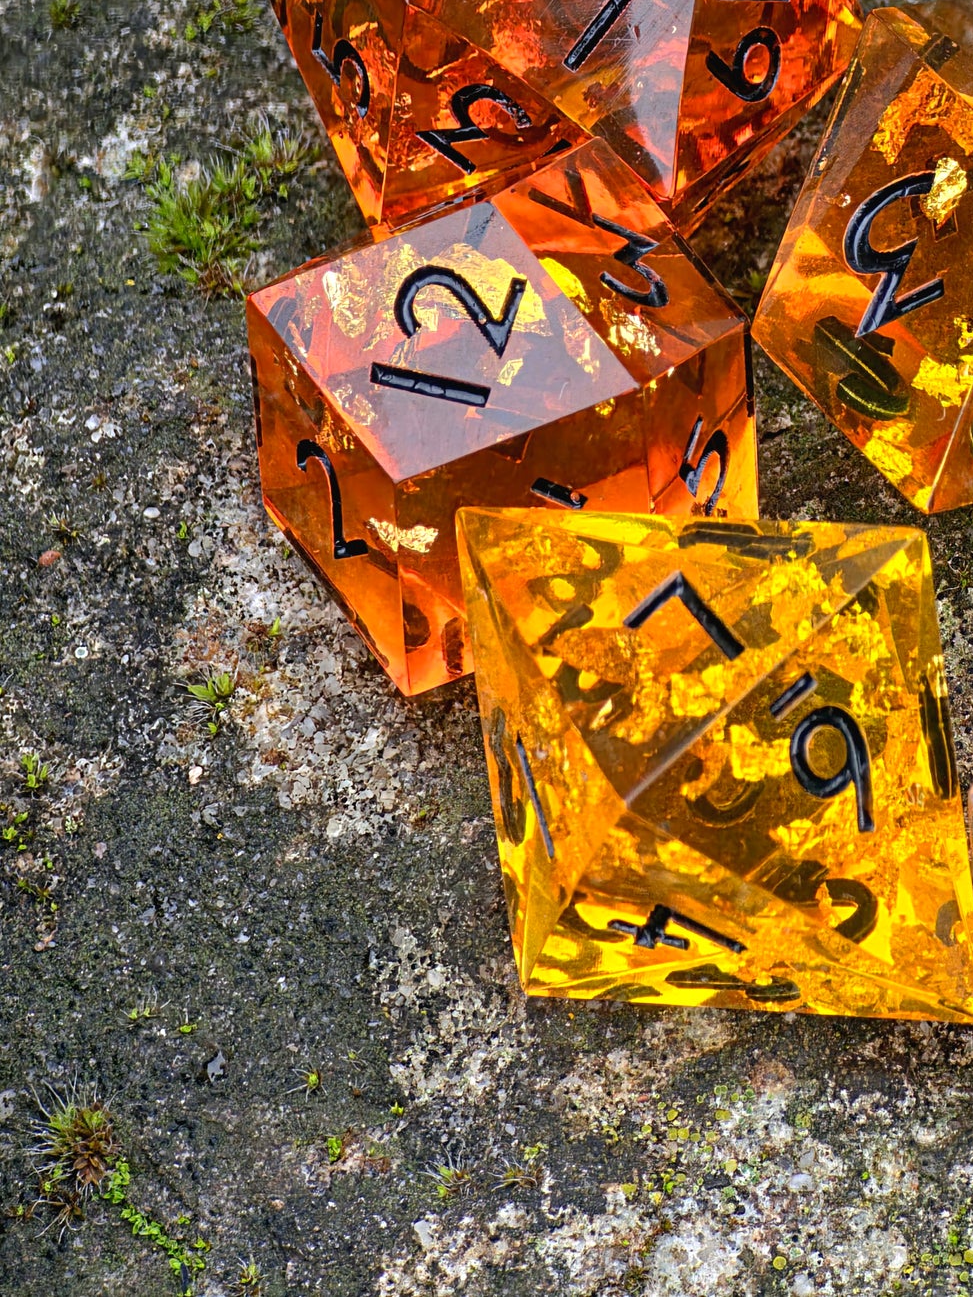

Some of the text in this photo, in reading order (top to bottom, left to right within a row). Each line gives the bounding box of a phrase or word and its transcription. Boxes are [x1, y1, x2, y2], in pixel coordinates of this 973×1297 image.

[600, 212, 670, 308] 3
[843, 170, 950, 338] 3
[369, 264, 528, 409] 12
[623, 570, 746, 662] 7
[607, 903, 748, 955] 4
